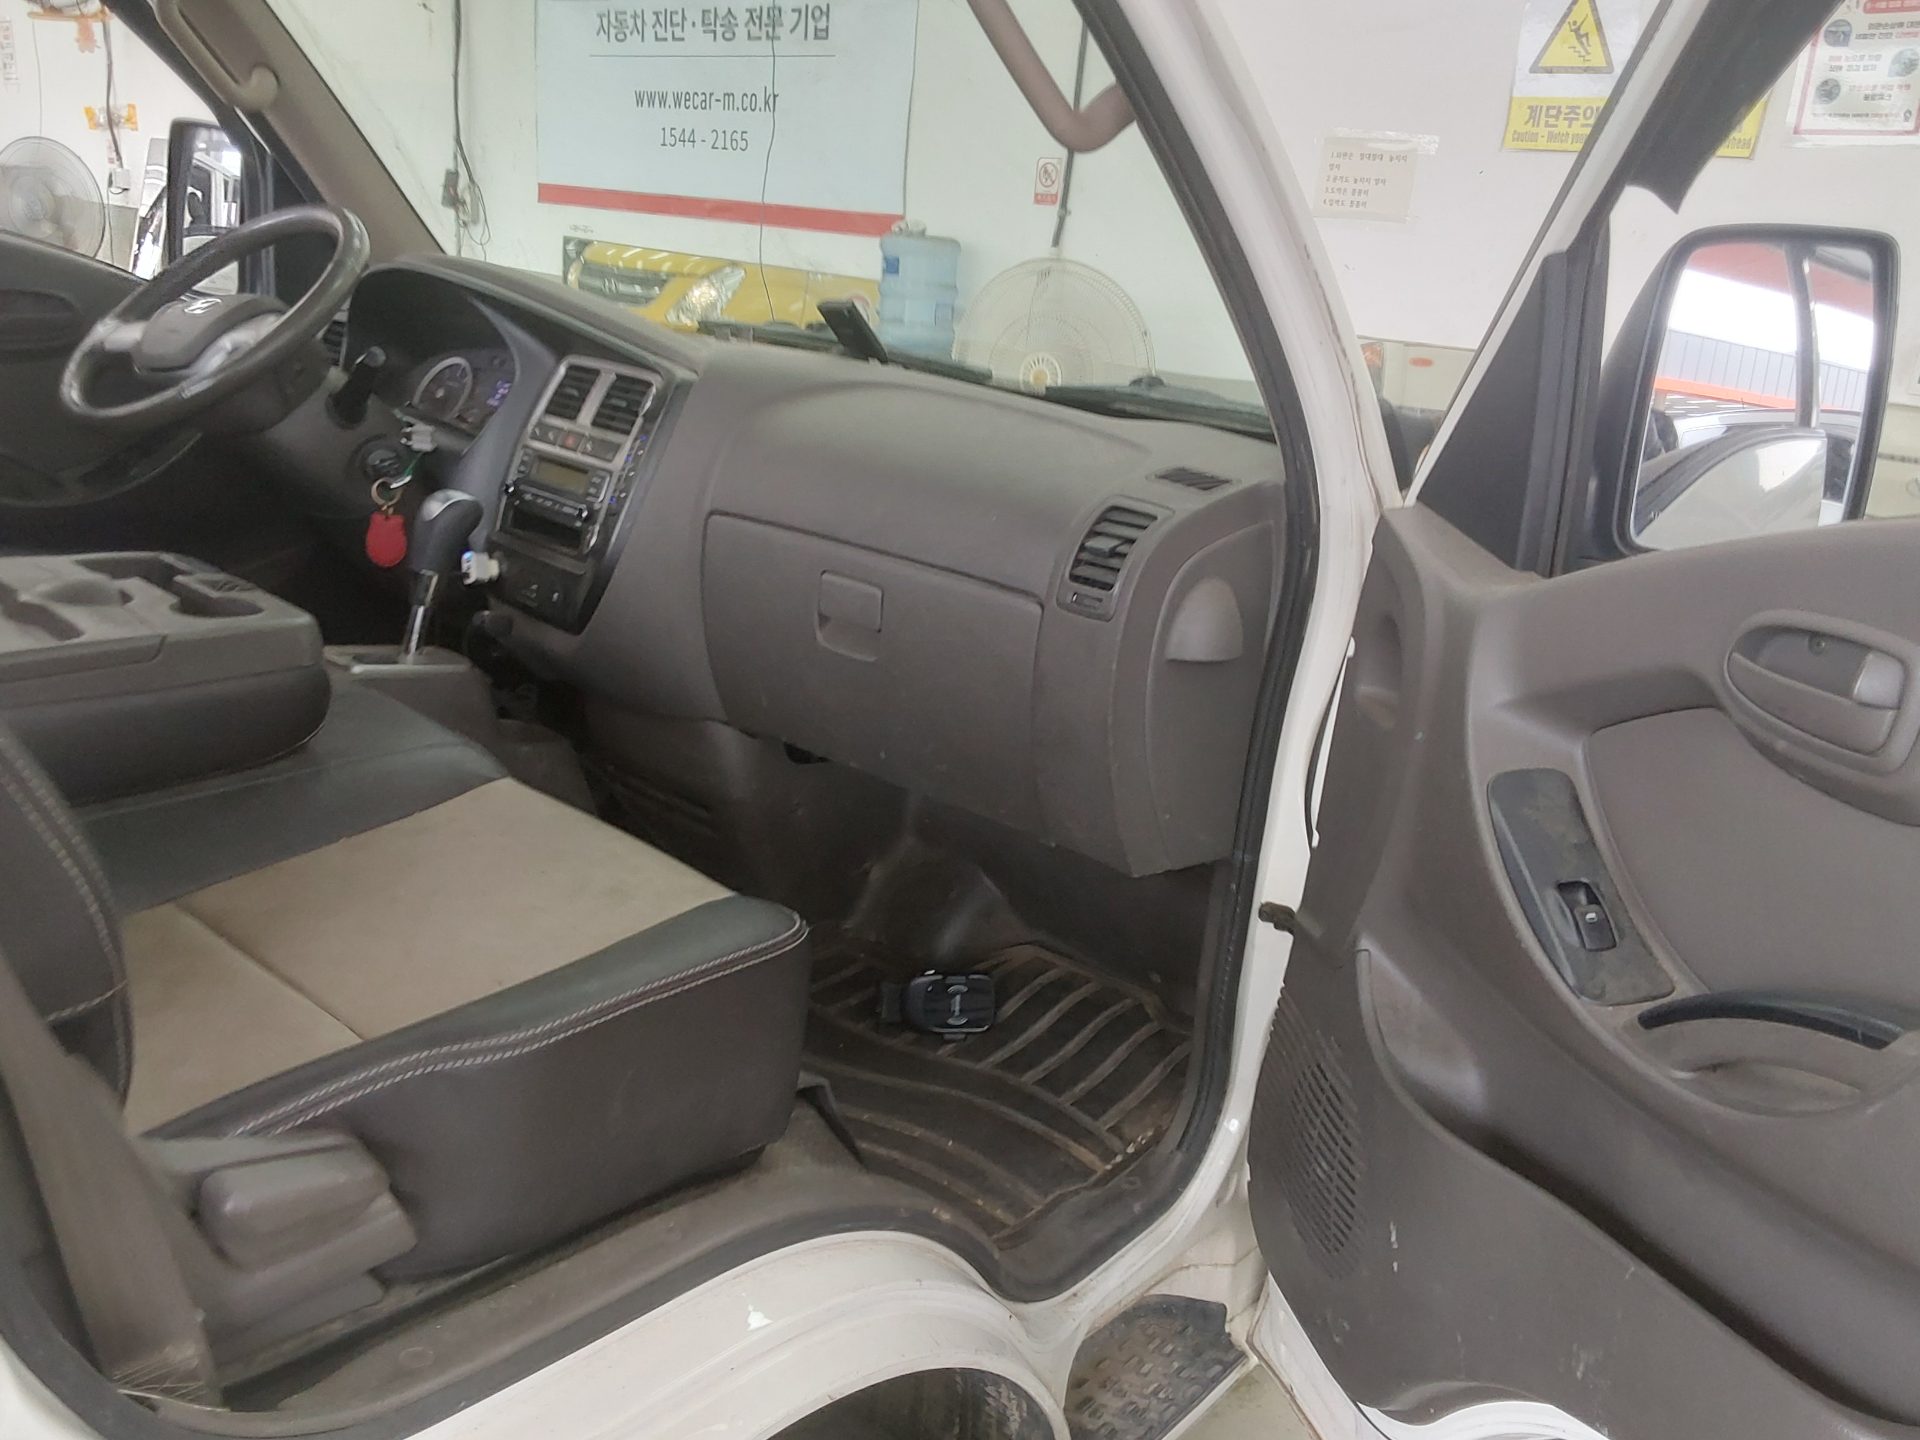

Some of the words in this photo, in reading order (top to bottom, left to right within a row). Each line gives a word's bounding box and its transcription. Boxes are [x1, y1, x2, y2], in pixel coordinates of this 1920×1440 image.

[596, 8, 647, 43] 자동차
[745, 4, 784, 41] 전문
[789, 3, 831, 41] 기업
[634, 86, 779, 113] www.wecar-m.co.kr
[1511, 130, 1540, 143] Caution
[1546, 131, 1570, 144] Watch
